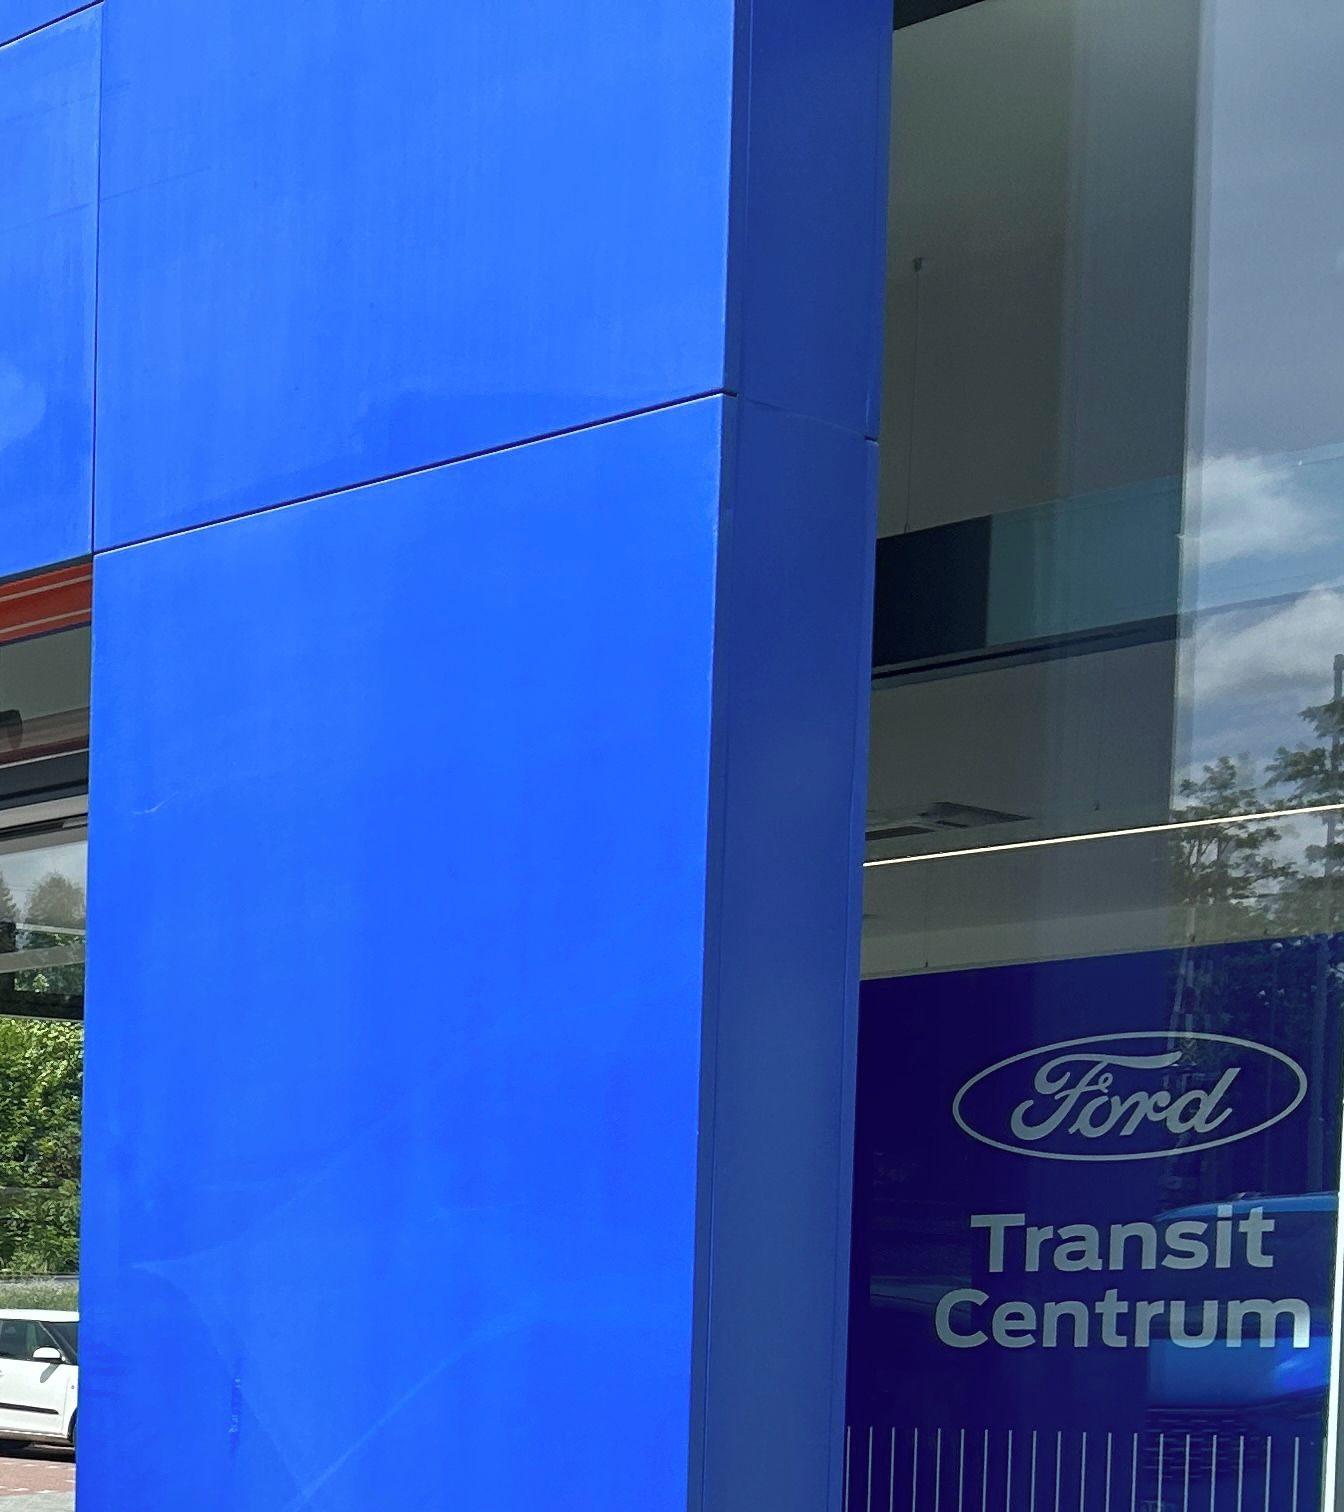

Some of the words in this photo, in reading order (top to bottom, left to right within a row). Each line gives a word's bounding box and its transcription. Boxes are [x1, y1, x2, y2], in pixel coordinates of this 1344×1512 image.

[1009, 1050, 1242, 1141] Ford
[970, 1204, 1276, 1274] Transit
[933, 1288, 1311, 1349] Centrum
